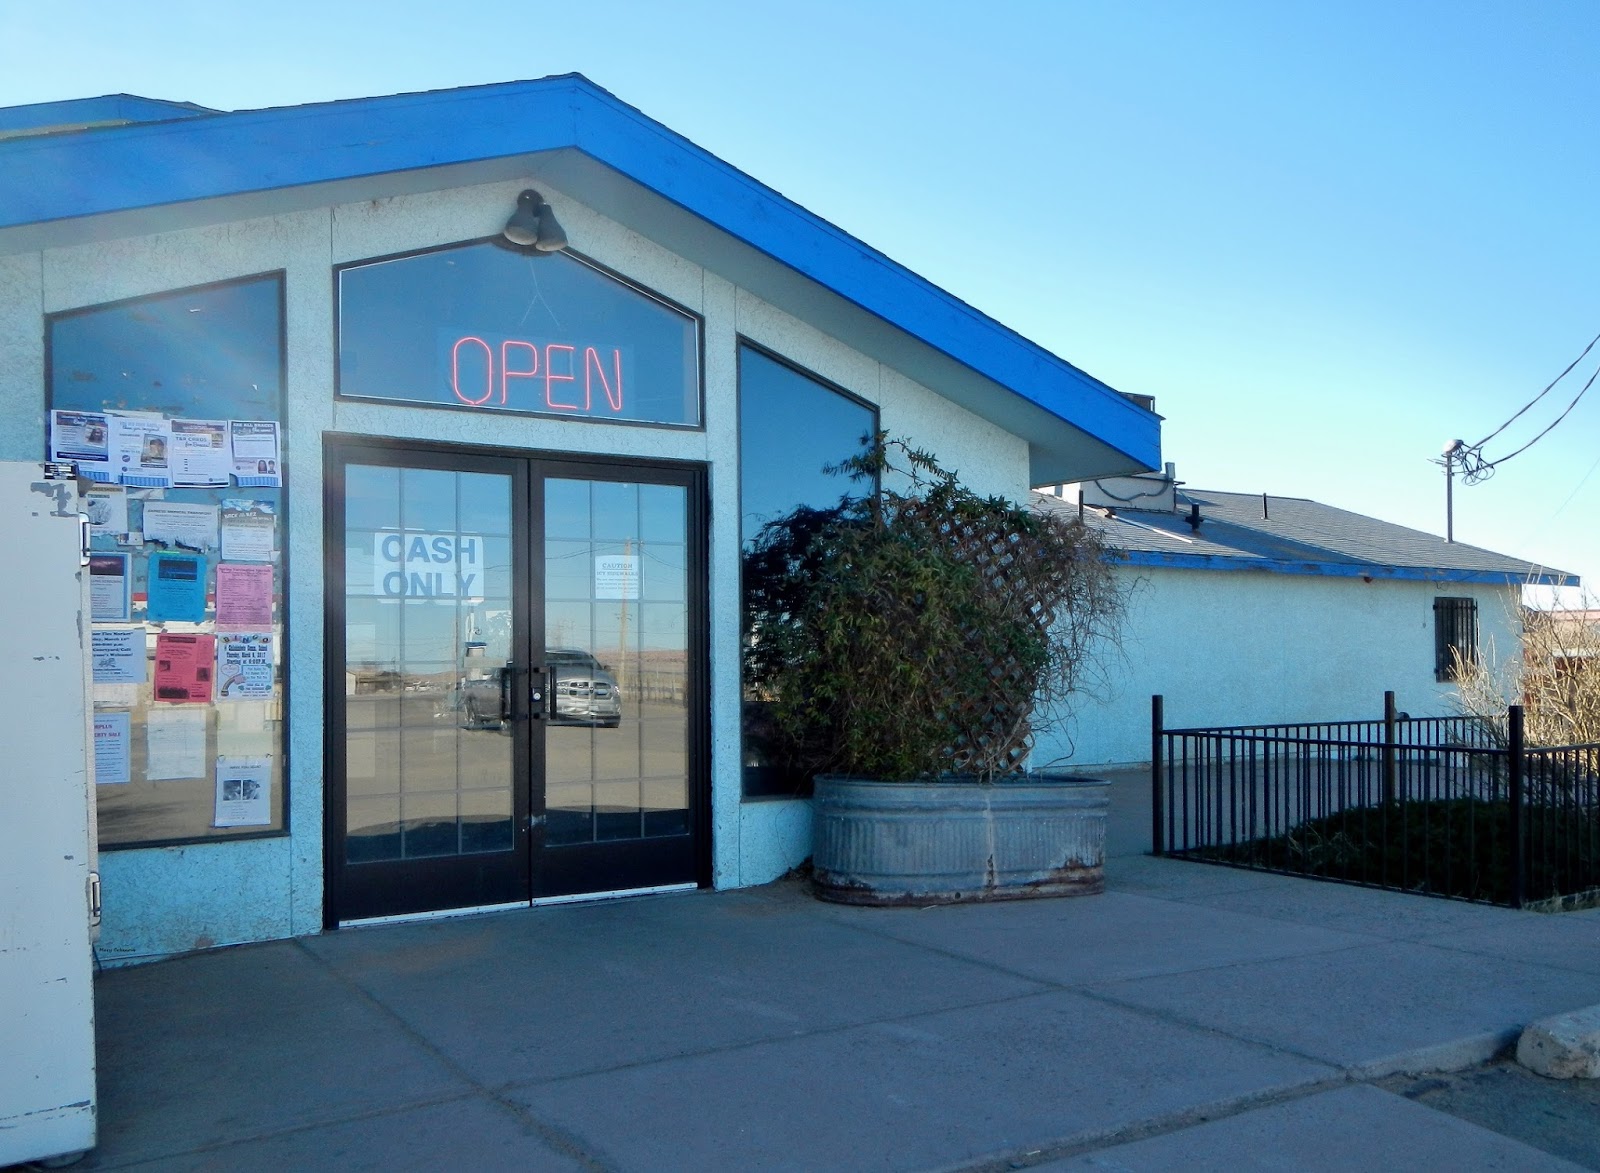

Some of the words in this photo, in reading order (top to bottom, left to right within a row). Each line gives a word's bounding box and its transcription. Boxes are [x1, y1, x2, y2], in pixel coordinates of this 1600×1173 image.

[453, 336, 623, 411] OPEN
[381, 534, 476, 564] CASH
[383, 571, 476, 598] ONLY
[223, 634, 269, 643] BINGO
